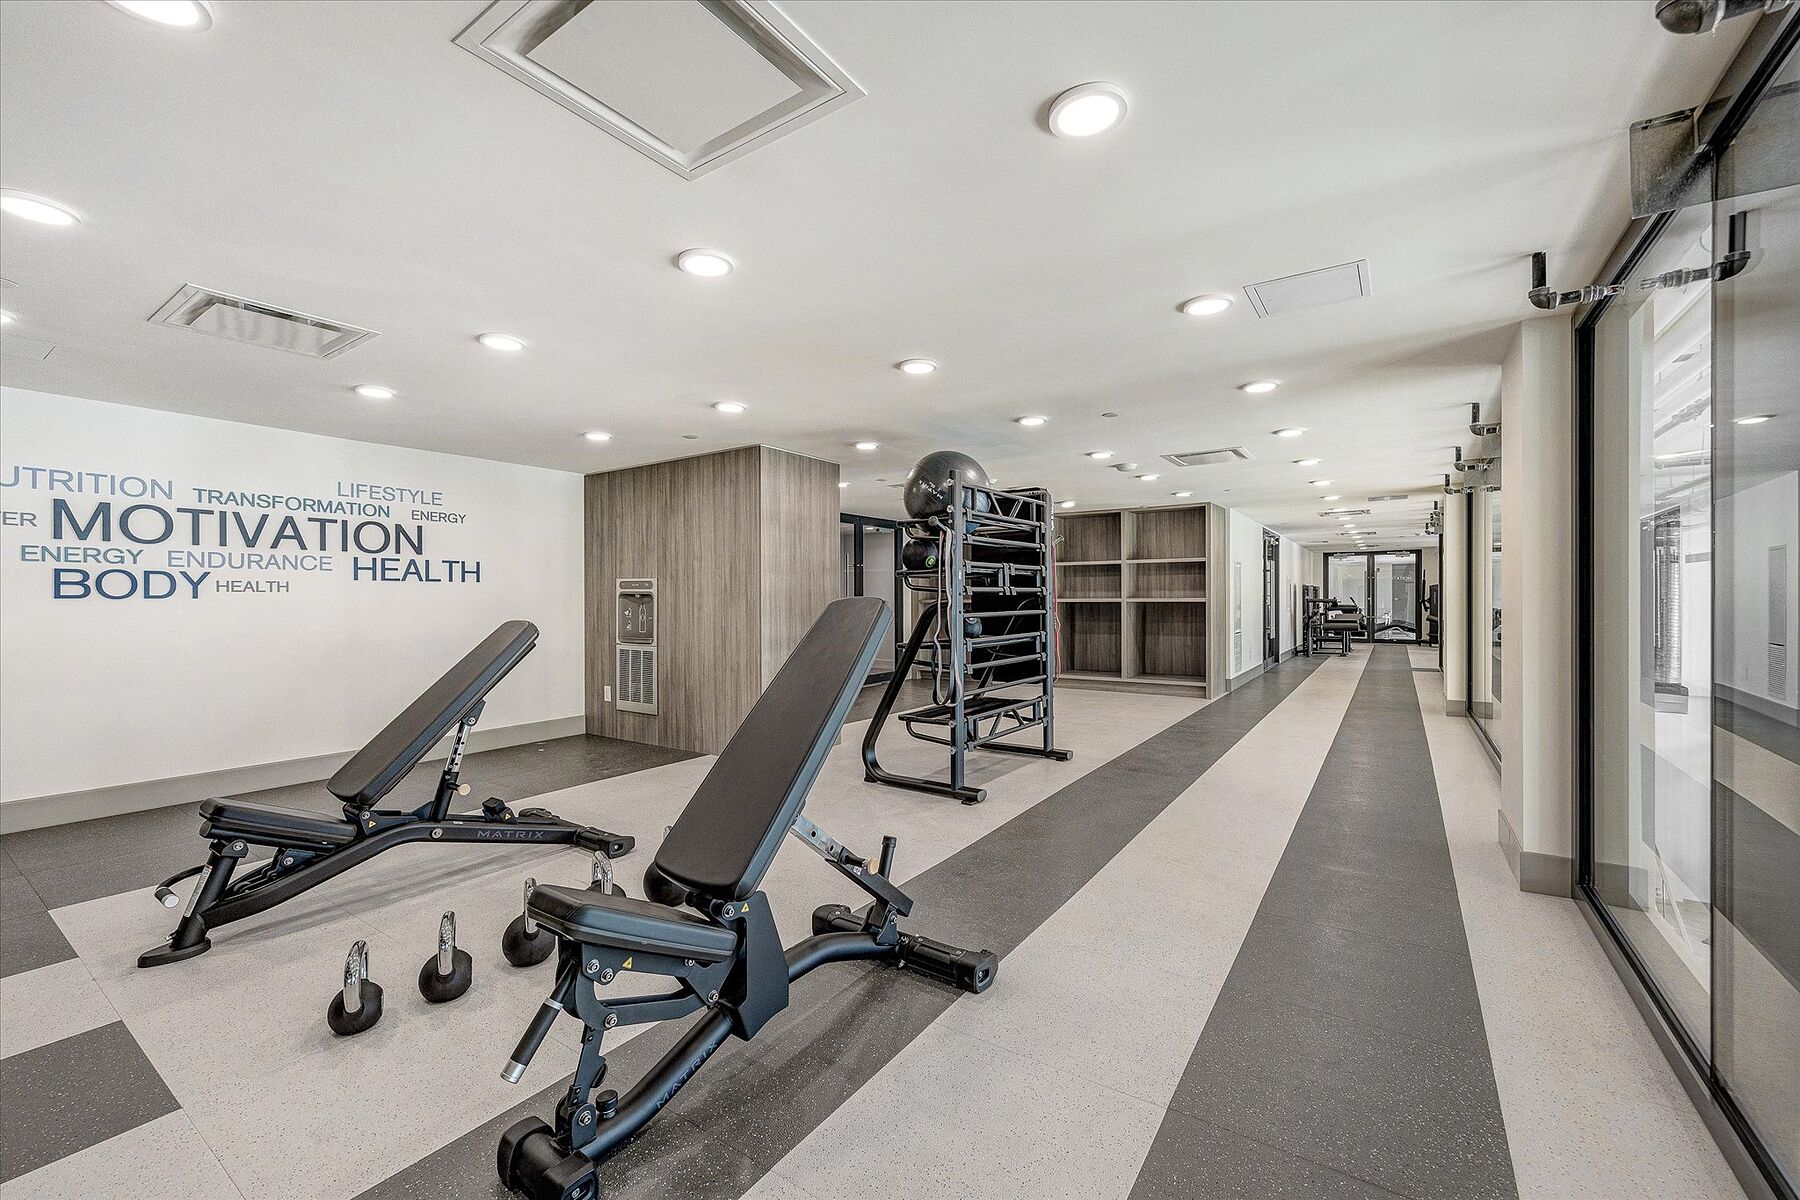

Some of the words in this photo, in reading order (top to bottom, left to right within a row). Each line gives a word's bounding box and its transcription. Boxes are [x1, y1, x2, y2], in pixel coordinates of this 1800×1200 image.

[192, 487, 390, 518] TRANSFORMATION
[337, 481, 443, 506] LIFESTYLE
[0, 510, 38, 527] ER
[53, 498, 423, 556] MOTIVATION
[411, 509, 467, 524] ENERGY
[20, 544, 144, 565] ENERGY
[167, 550, 333, 572] ENDURANCE
[353, 556, 481, 583] HEALTH
[53, 568, 211, 600] BODY
[215, 580, 289, 593] HEALTH
[477, 830, 545, 839] MATRIX
[656, 1040, 717, 1109] MATRIX
